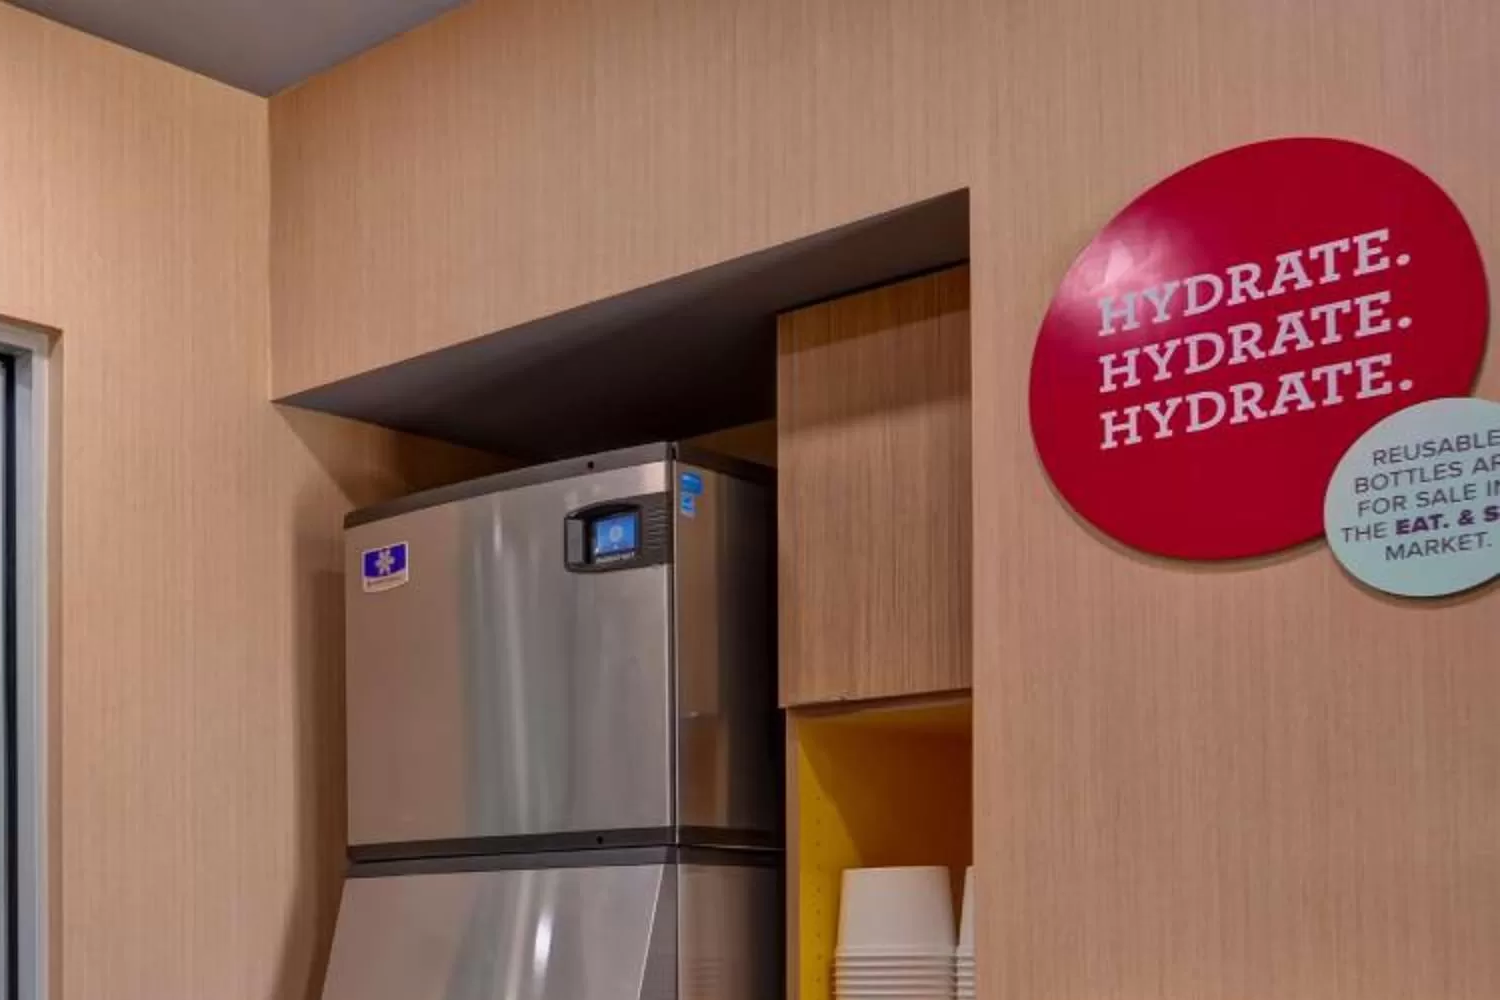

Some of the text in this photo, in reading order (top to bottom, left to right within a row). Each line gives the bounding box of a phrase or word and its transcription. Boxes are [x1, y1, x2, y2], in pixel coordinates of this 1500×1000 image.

[1099, 228, 1411, 337] HYDRATE.
[1099, 291, 1413, 393] HYDRATE.
[1100, 352, 1413, 450] HYDRATE.
[1373, 429, 1500, 466] REUSABLE
[1355, 461, 1463, 494] BOTTLES
[1357, 495, 1407, 517] FOR
[1416, 483, 1477, 508] SALE
[1341, 521, 1388, 544] THE
[1395, 513, 1449, 535] EAT.
[1457, 509, 1475, 526] &
[1385, 531, 1492, 561] MARKET.
